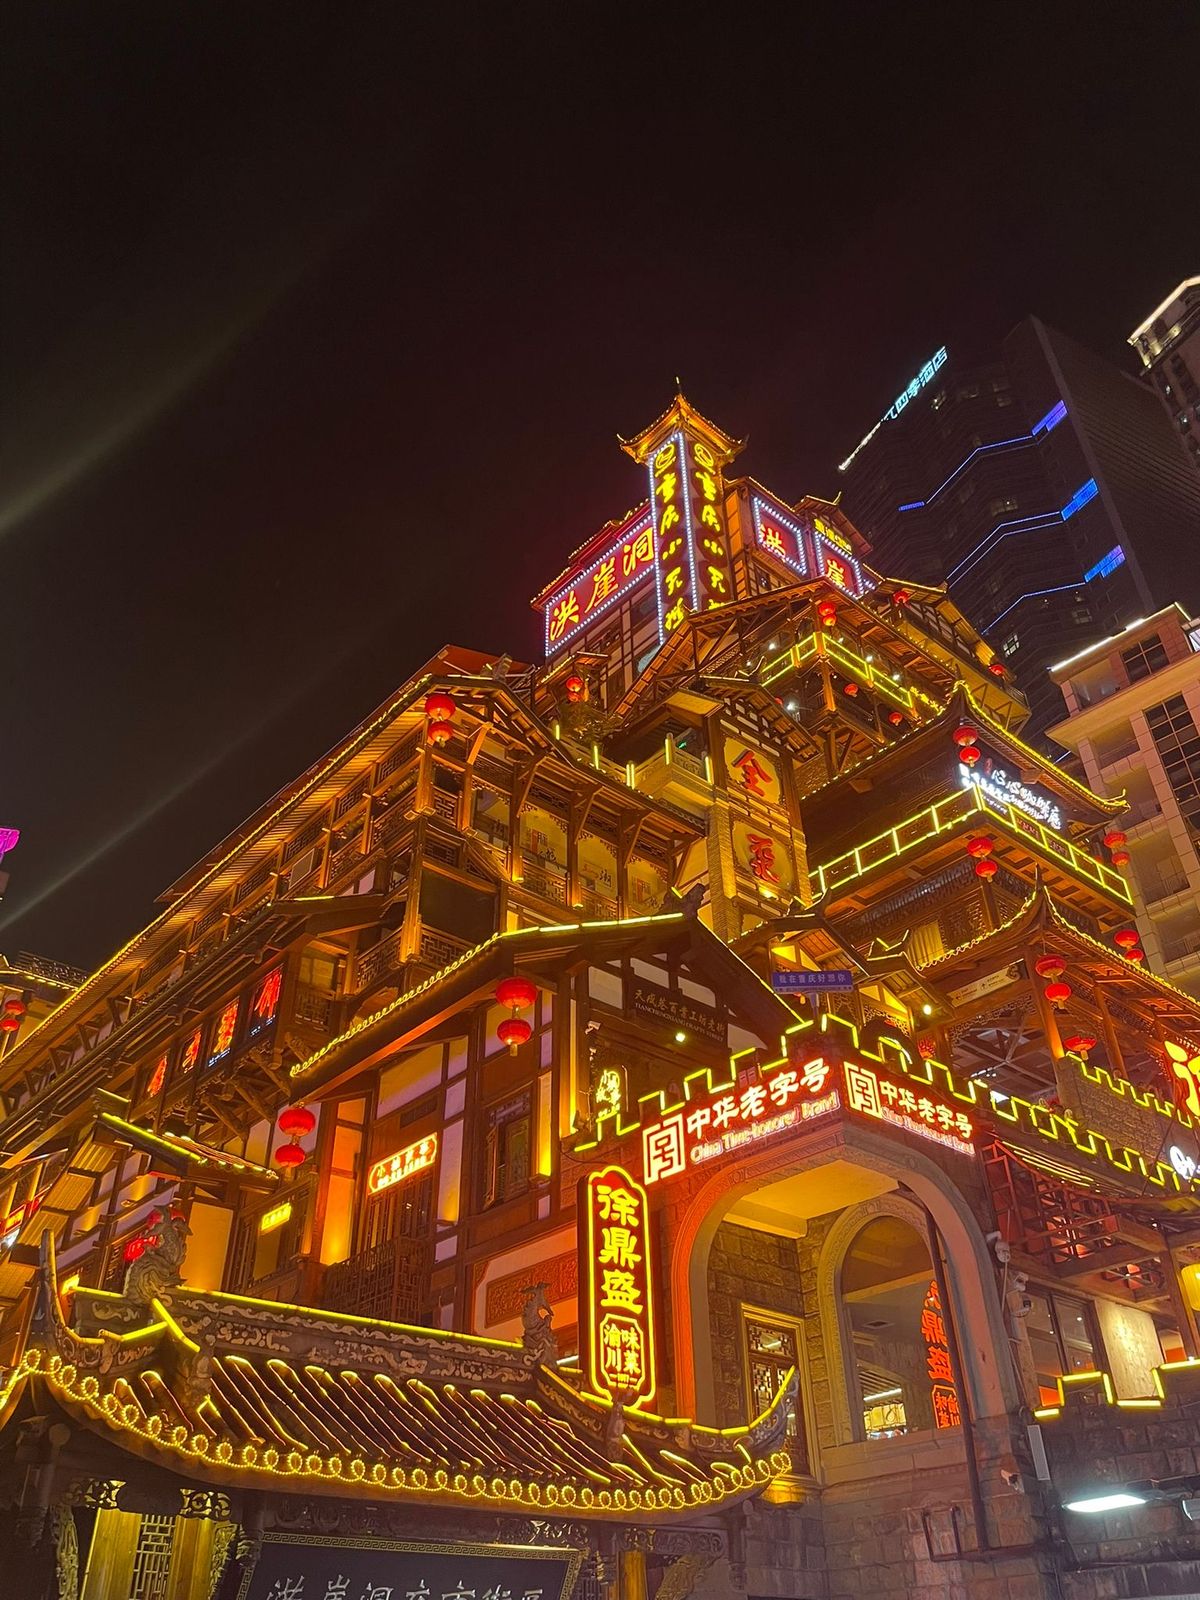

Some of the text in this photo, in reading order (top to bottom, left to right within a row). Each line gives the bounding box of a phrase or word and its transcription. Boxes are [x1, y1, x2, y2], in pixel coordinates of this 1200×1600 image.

[549, 527, 655, 641] 洪崖洞
[695, 471, 726, 610] 重庆小天
[687, 1057, 830, 1139] 中华老字号
[879, 1081, 973, 1139] 中华老字号
[690, 1140, 723, 1164] China
[597, 1185, 643, 1315] 徐鼎盛
